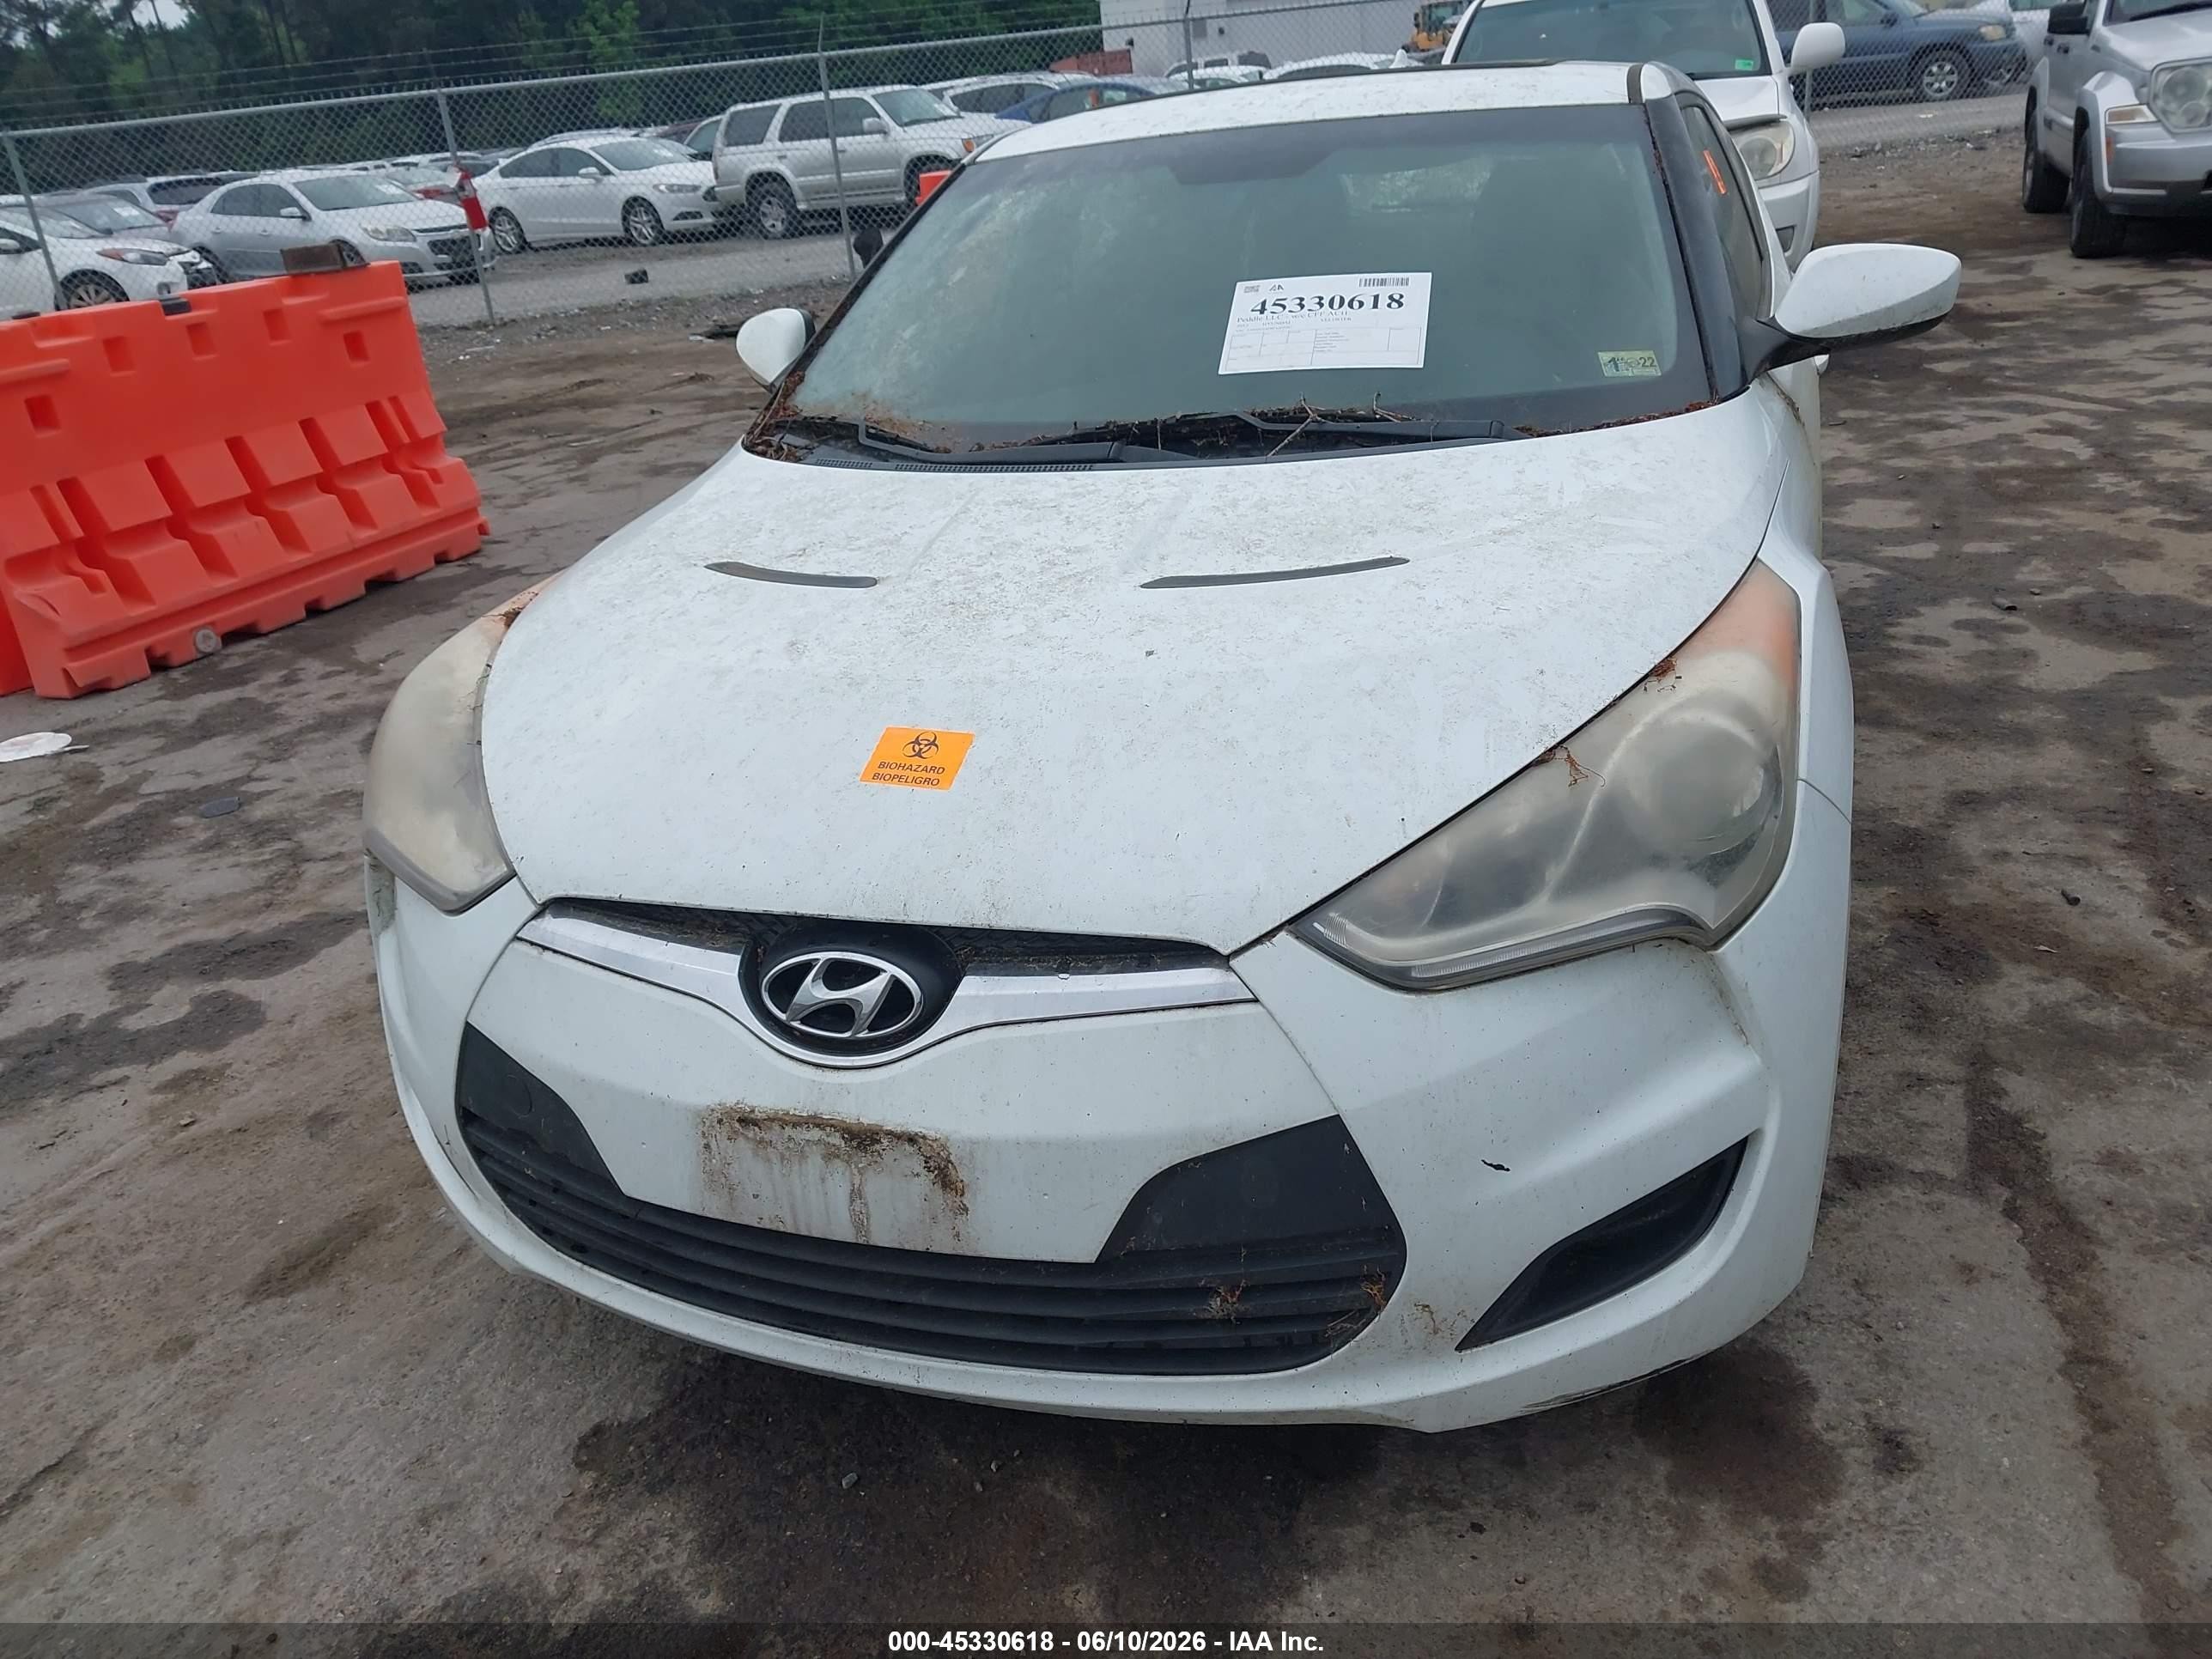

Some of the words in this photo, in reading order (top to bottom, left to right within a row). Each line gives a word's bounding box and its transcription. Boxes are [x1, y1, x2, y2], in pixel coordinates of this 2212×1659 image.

[1250, 292, 1406, 315] 45330618
[1638, 356, 1657, 368] 22
[878, 761, 945, 775] BIOHAZARD
[872, 772, 940, 787] BIOPELIGRO
